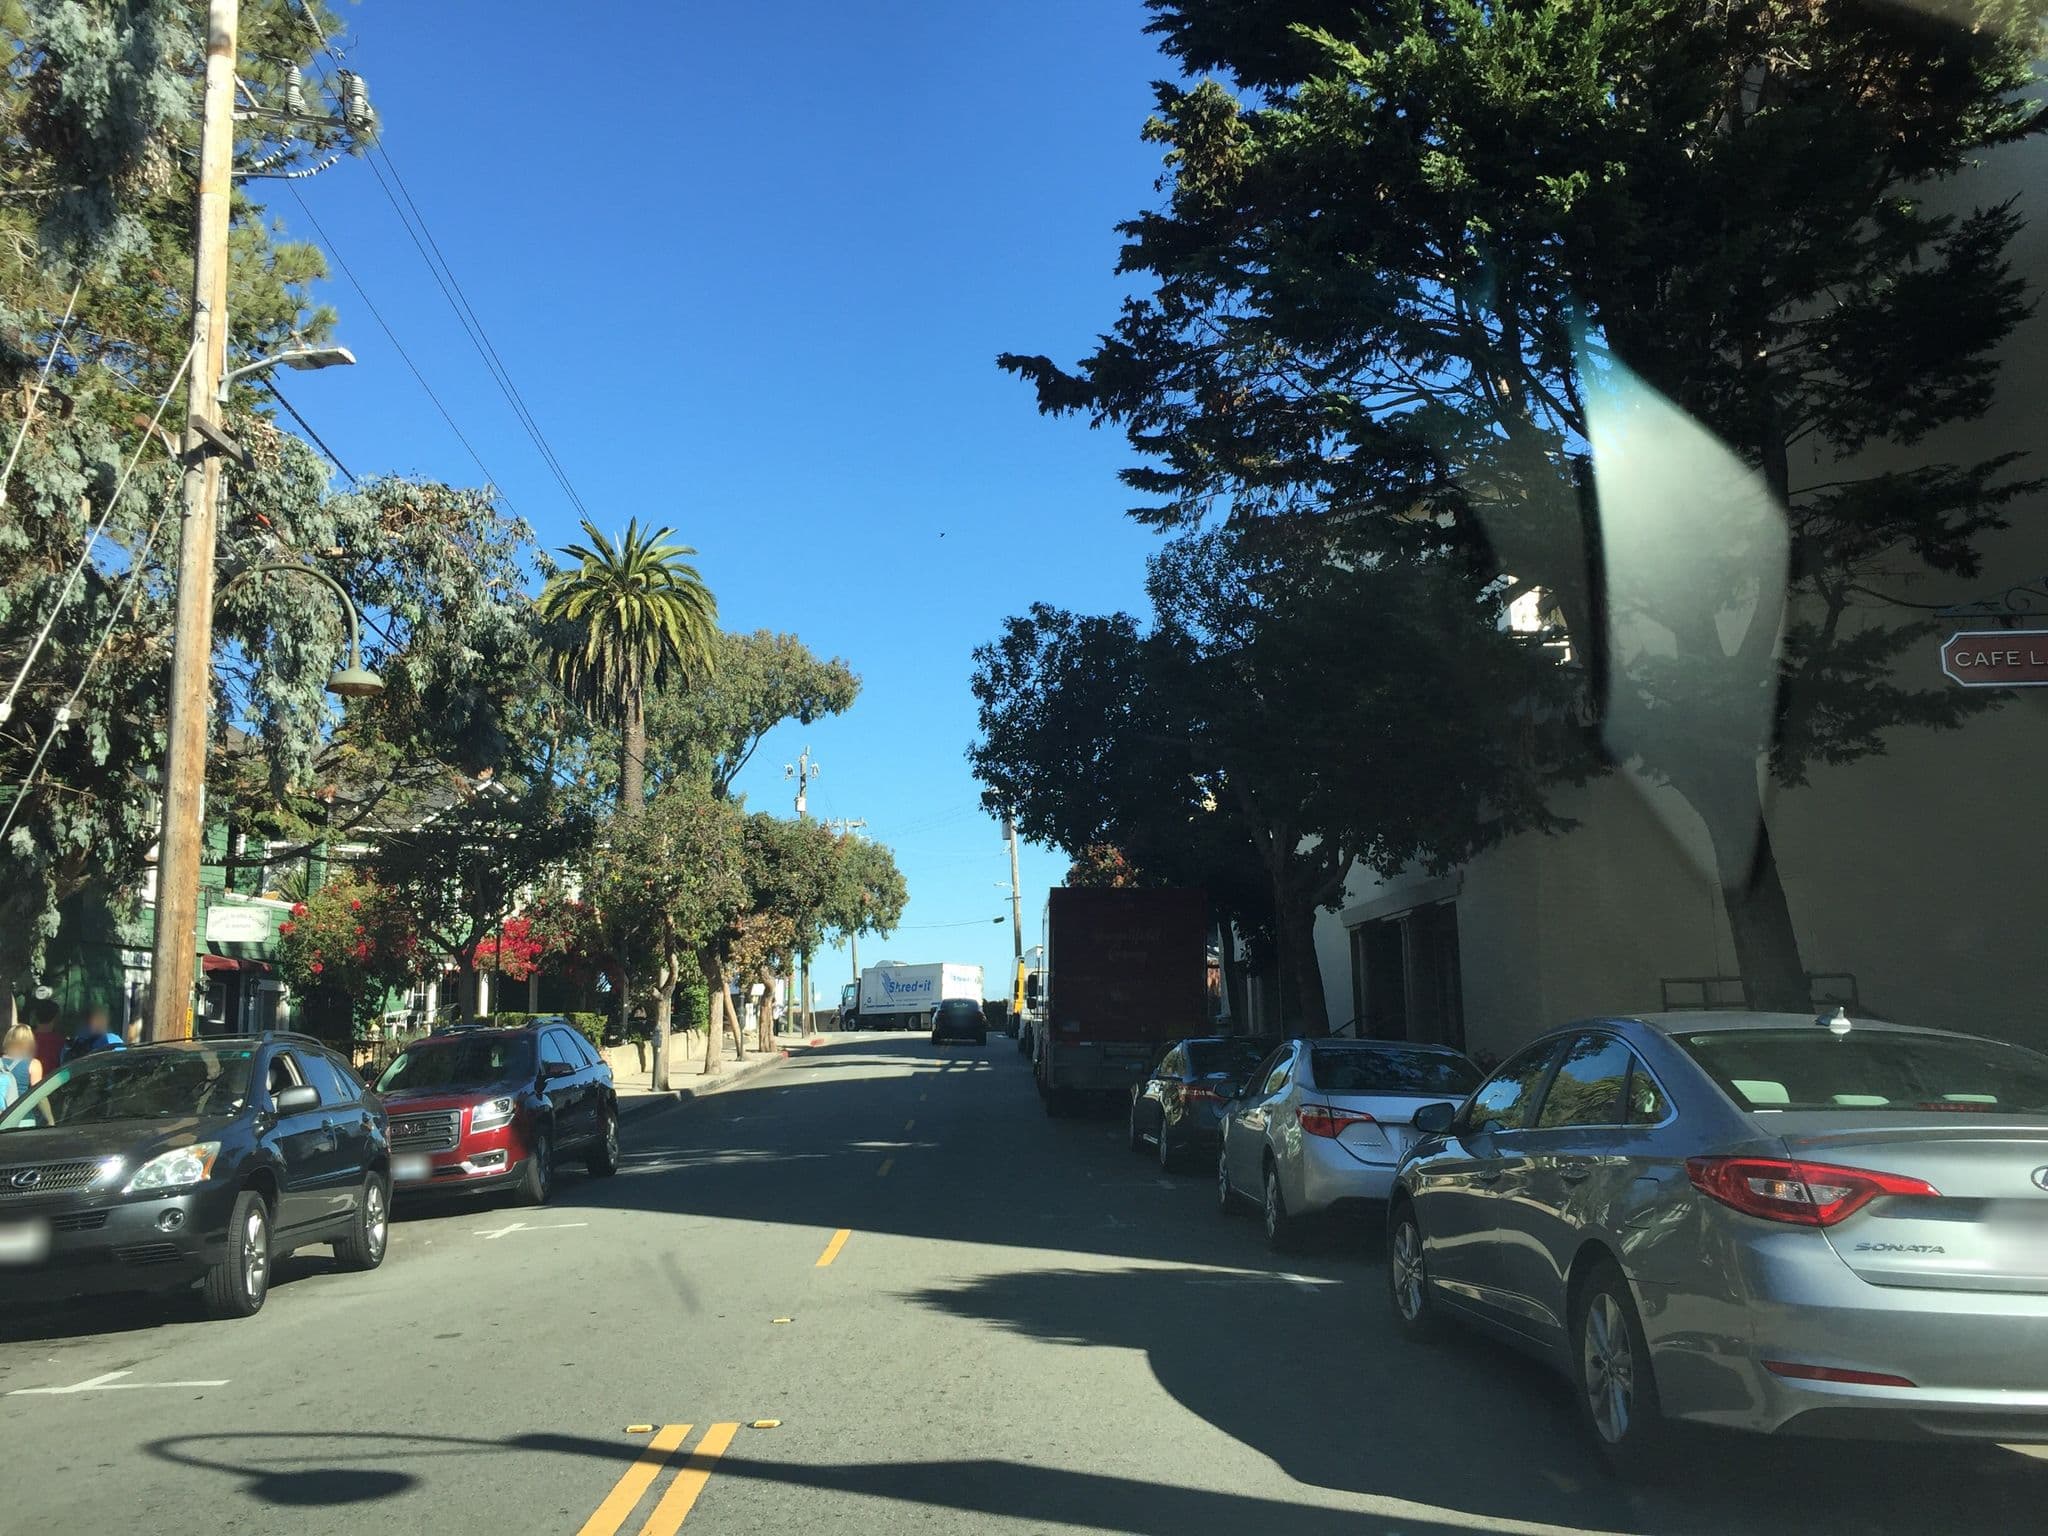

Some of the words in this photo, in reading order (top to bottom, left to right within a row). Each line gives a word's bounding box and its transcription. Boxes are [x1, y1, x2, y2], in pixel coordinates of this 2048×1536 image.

[1955, 650, 2021, 667] CAFE
[2030, 650, 2048, 665] L
[889, 979, 932, 993] Shred-it
[1854, 1242, 1946, 1254] SONATA
